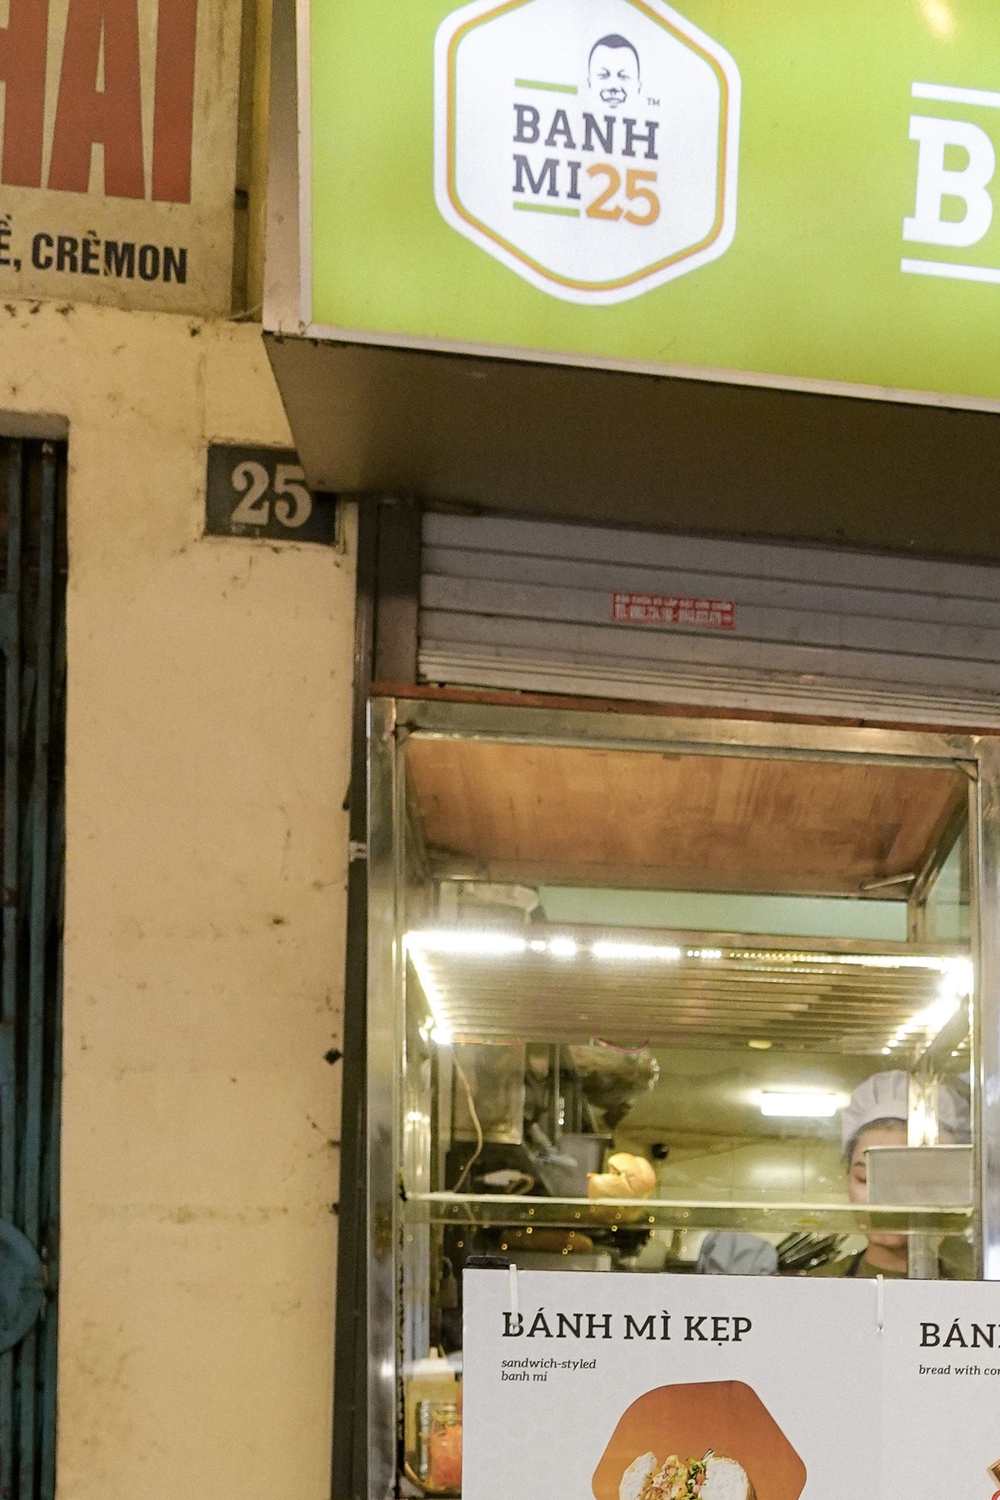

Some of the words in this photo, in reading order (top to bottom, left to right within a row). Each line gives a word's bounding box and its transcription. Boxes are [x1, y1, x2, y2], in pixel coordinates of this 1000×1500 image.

[513, 103, 659, 160] BANH
[230, 461, 312, 528] 25
[502, 1307, 612, 1339] BÁNH
[624, 1310, 671, 1340] MÌ
[684, 1316, 752, 1346] KẸP
[501, 1371, 529, 1381] banh
[533, 1371, 547, 1381] mi
[502, 1358, 596, 1370] sandwich-styled
[919, 1364, 951, 1374] bread
[955, 1365, 980, 1375] with
